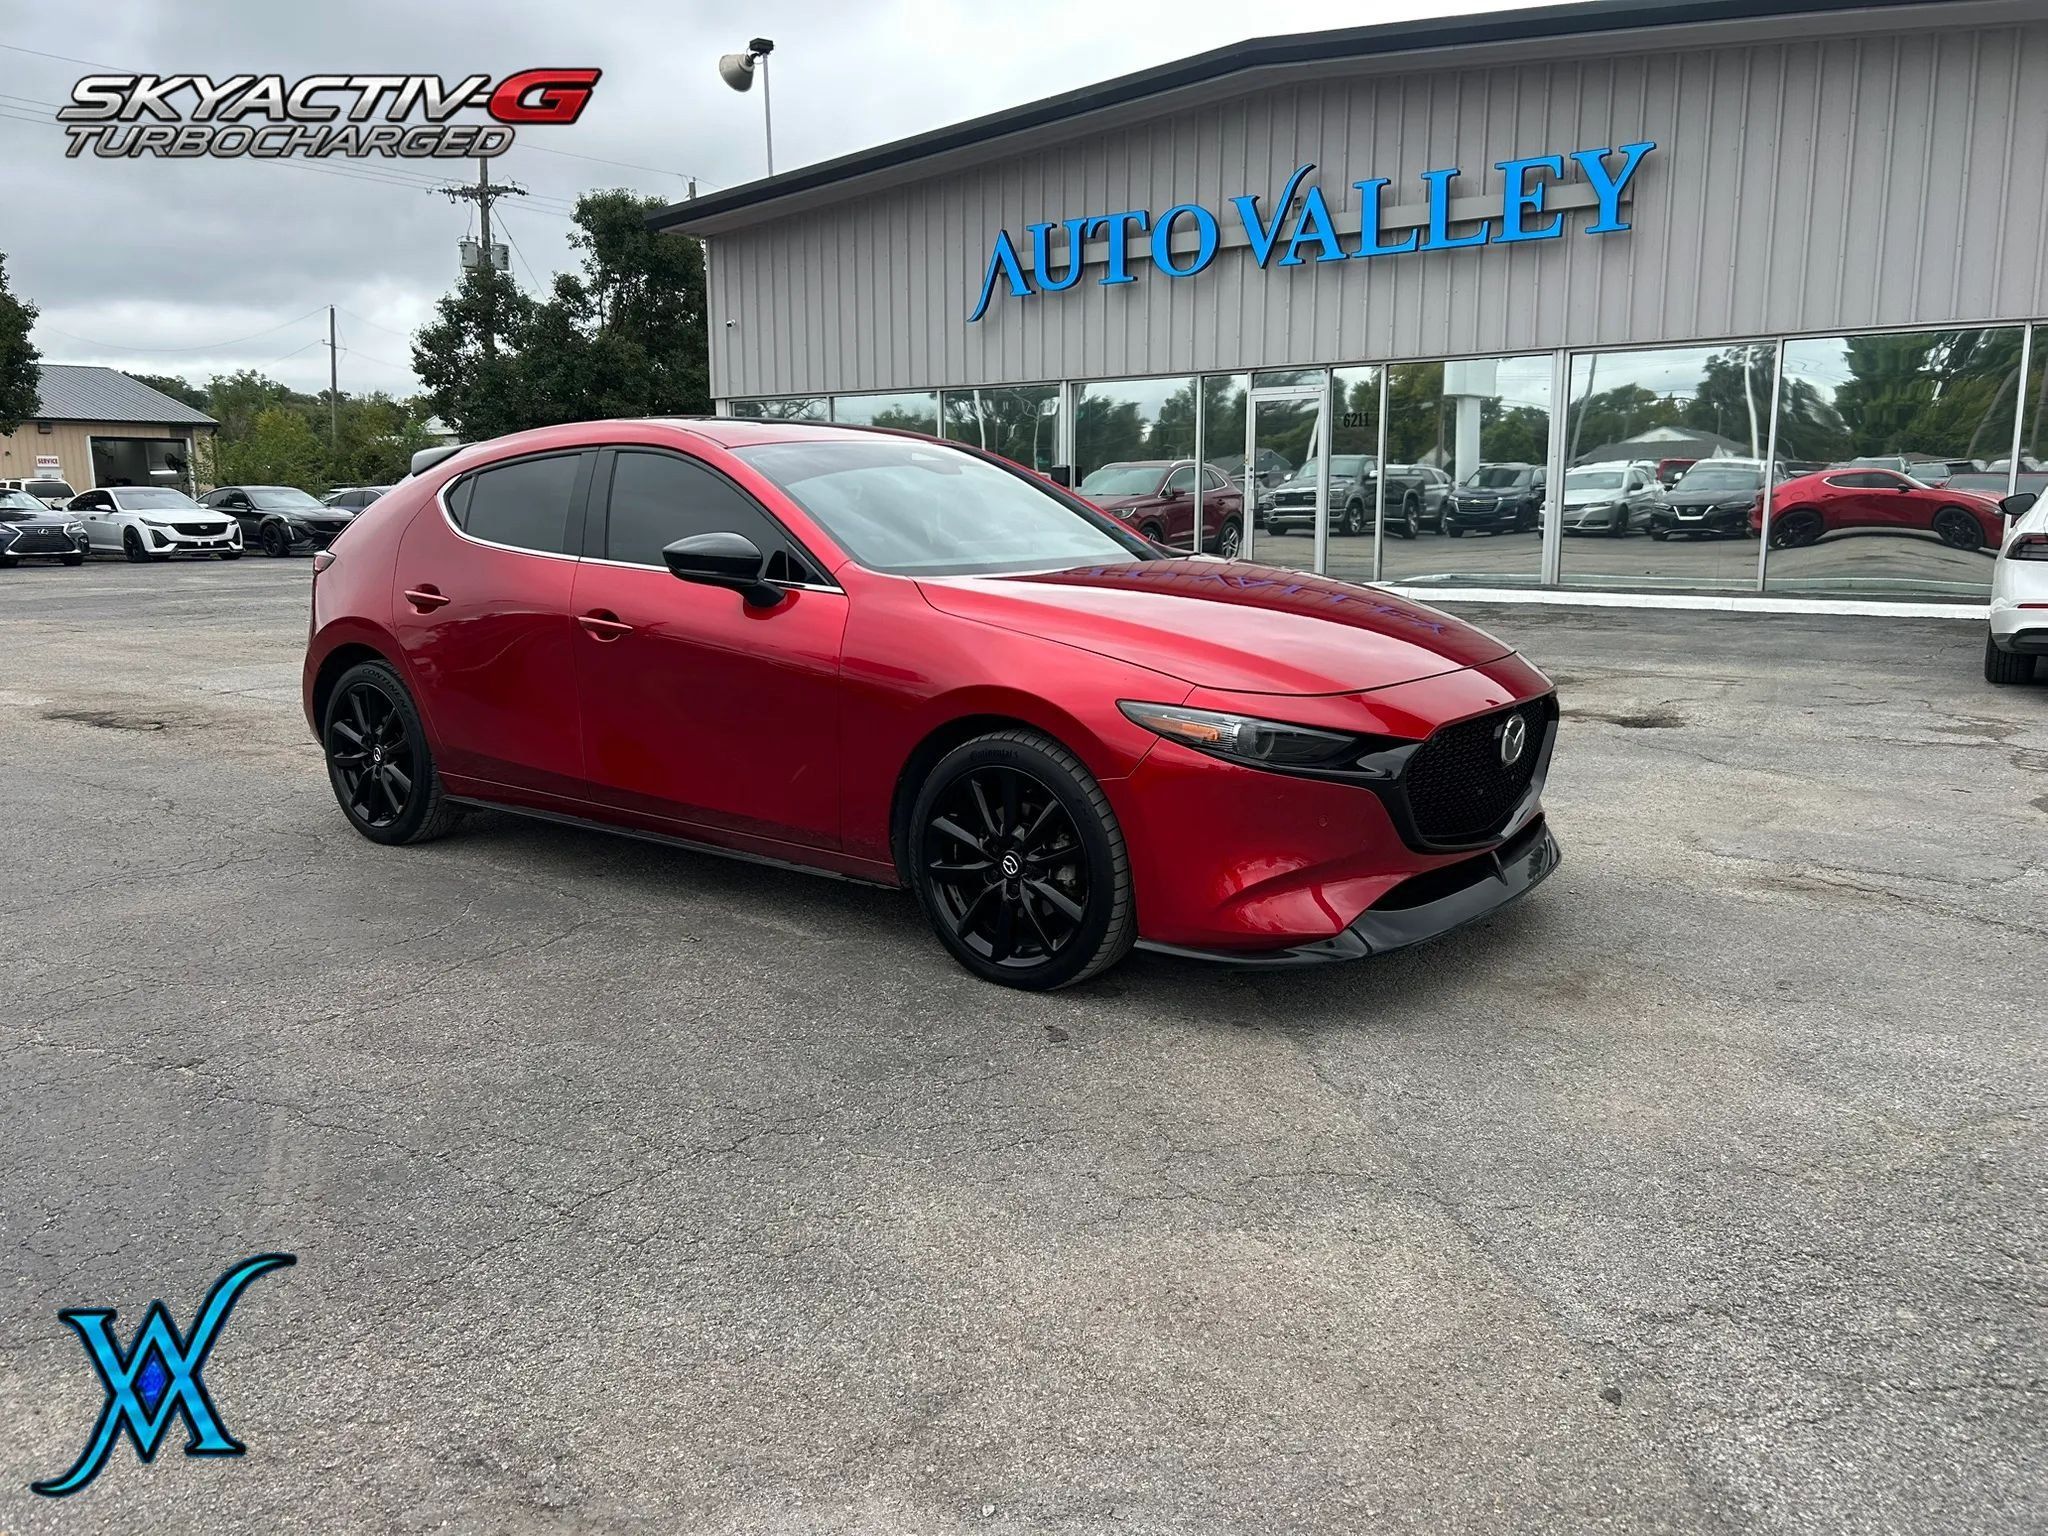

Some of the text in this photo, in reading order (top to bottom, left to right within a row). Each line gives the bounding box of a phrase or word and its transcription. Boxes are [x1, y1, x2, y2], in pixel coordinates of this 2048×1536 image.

[966, 141, 1657, 323] AUTO VALLEY
[1343, 412, 1370, 428] 6211
[362, 668, 413, 721] CONTINENT
